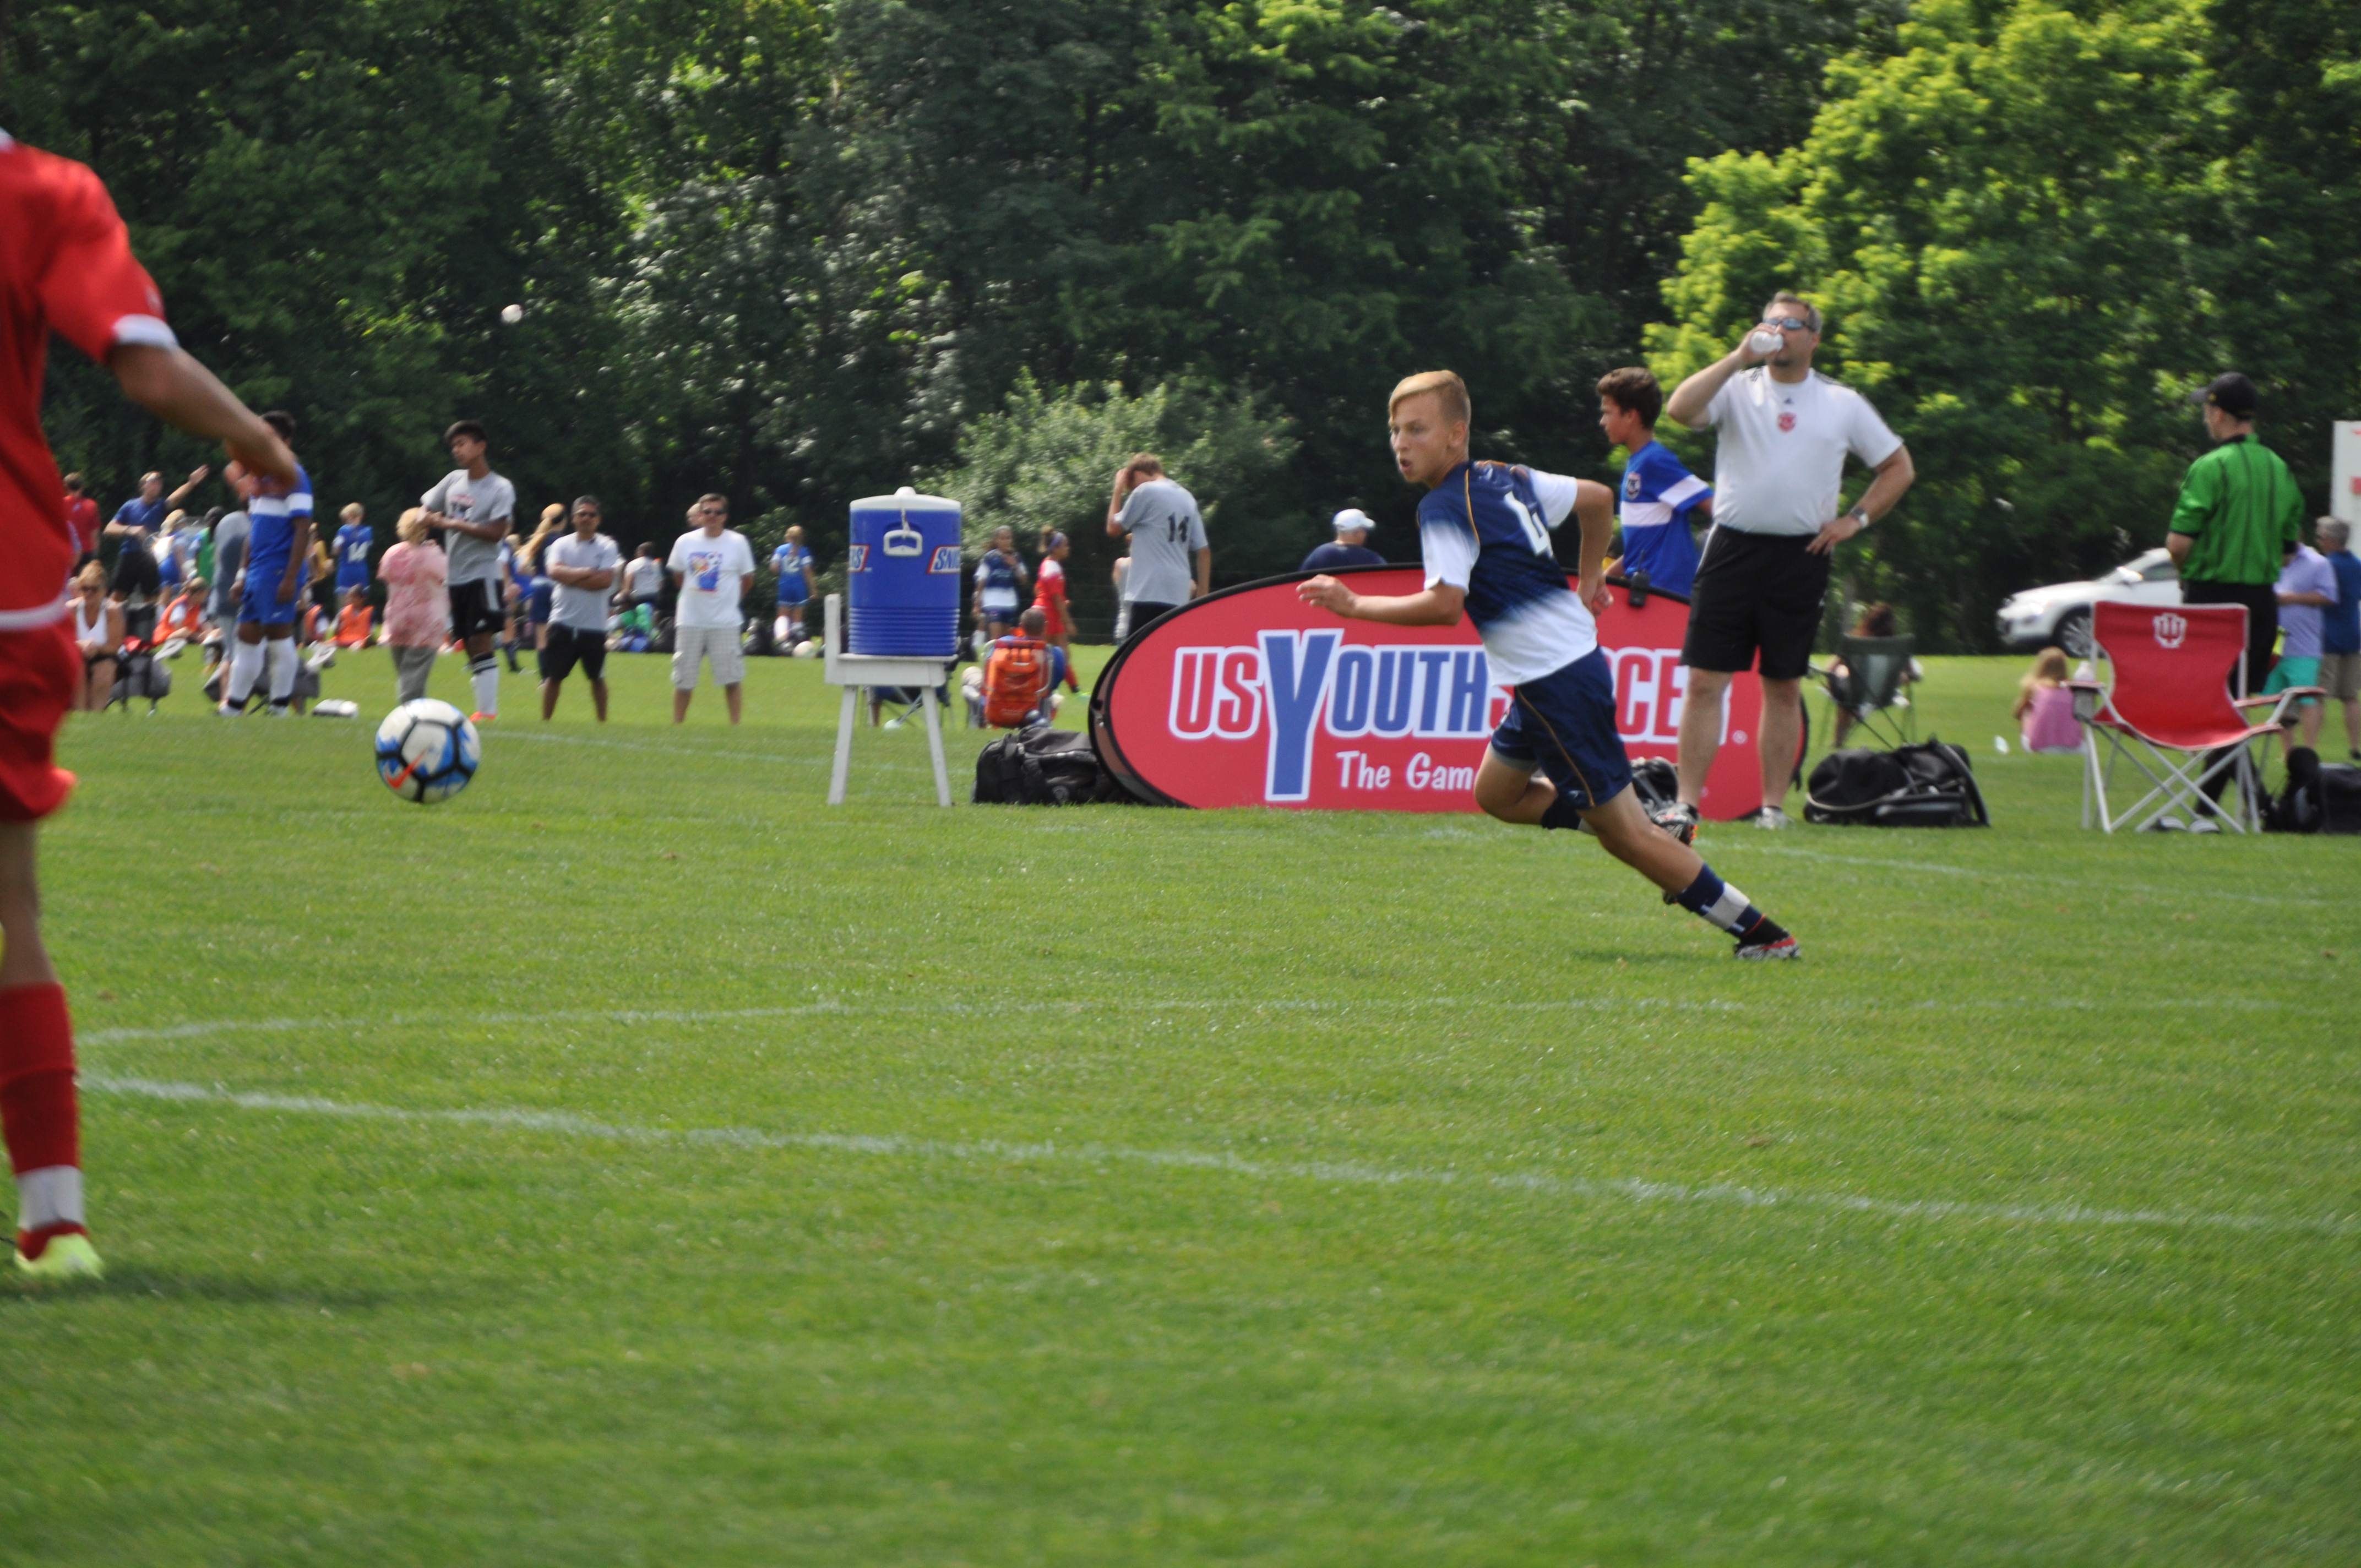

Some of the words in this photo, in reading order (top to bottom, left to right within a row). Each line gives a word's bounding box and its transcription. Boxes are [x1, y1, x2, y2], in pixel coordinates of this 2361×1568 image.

[1168, 512, 1189, 542] 14
[1169, 646, 1262, 739] US
[1336, 750, 1391, 790] The
[1406, 752, 1475, 791] Gam
